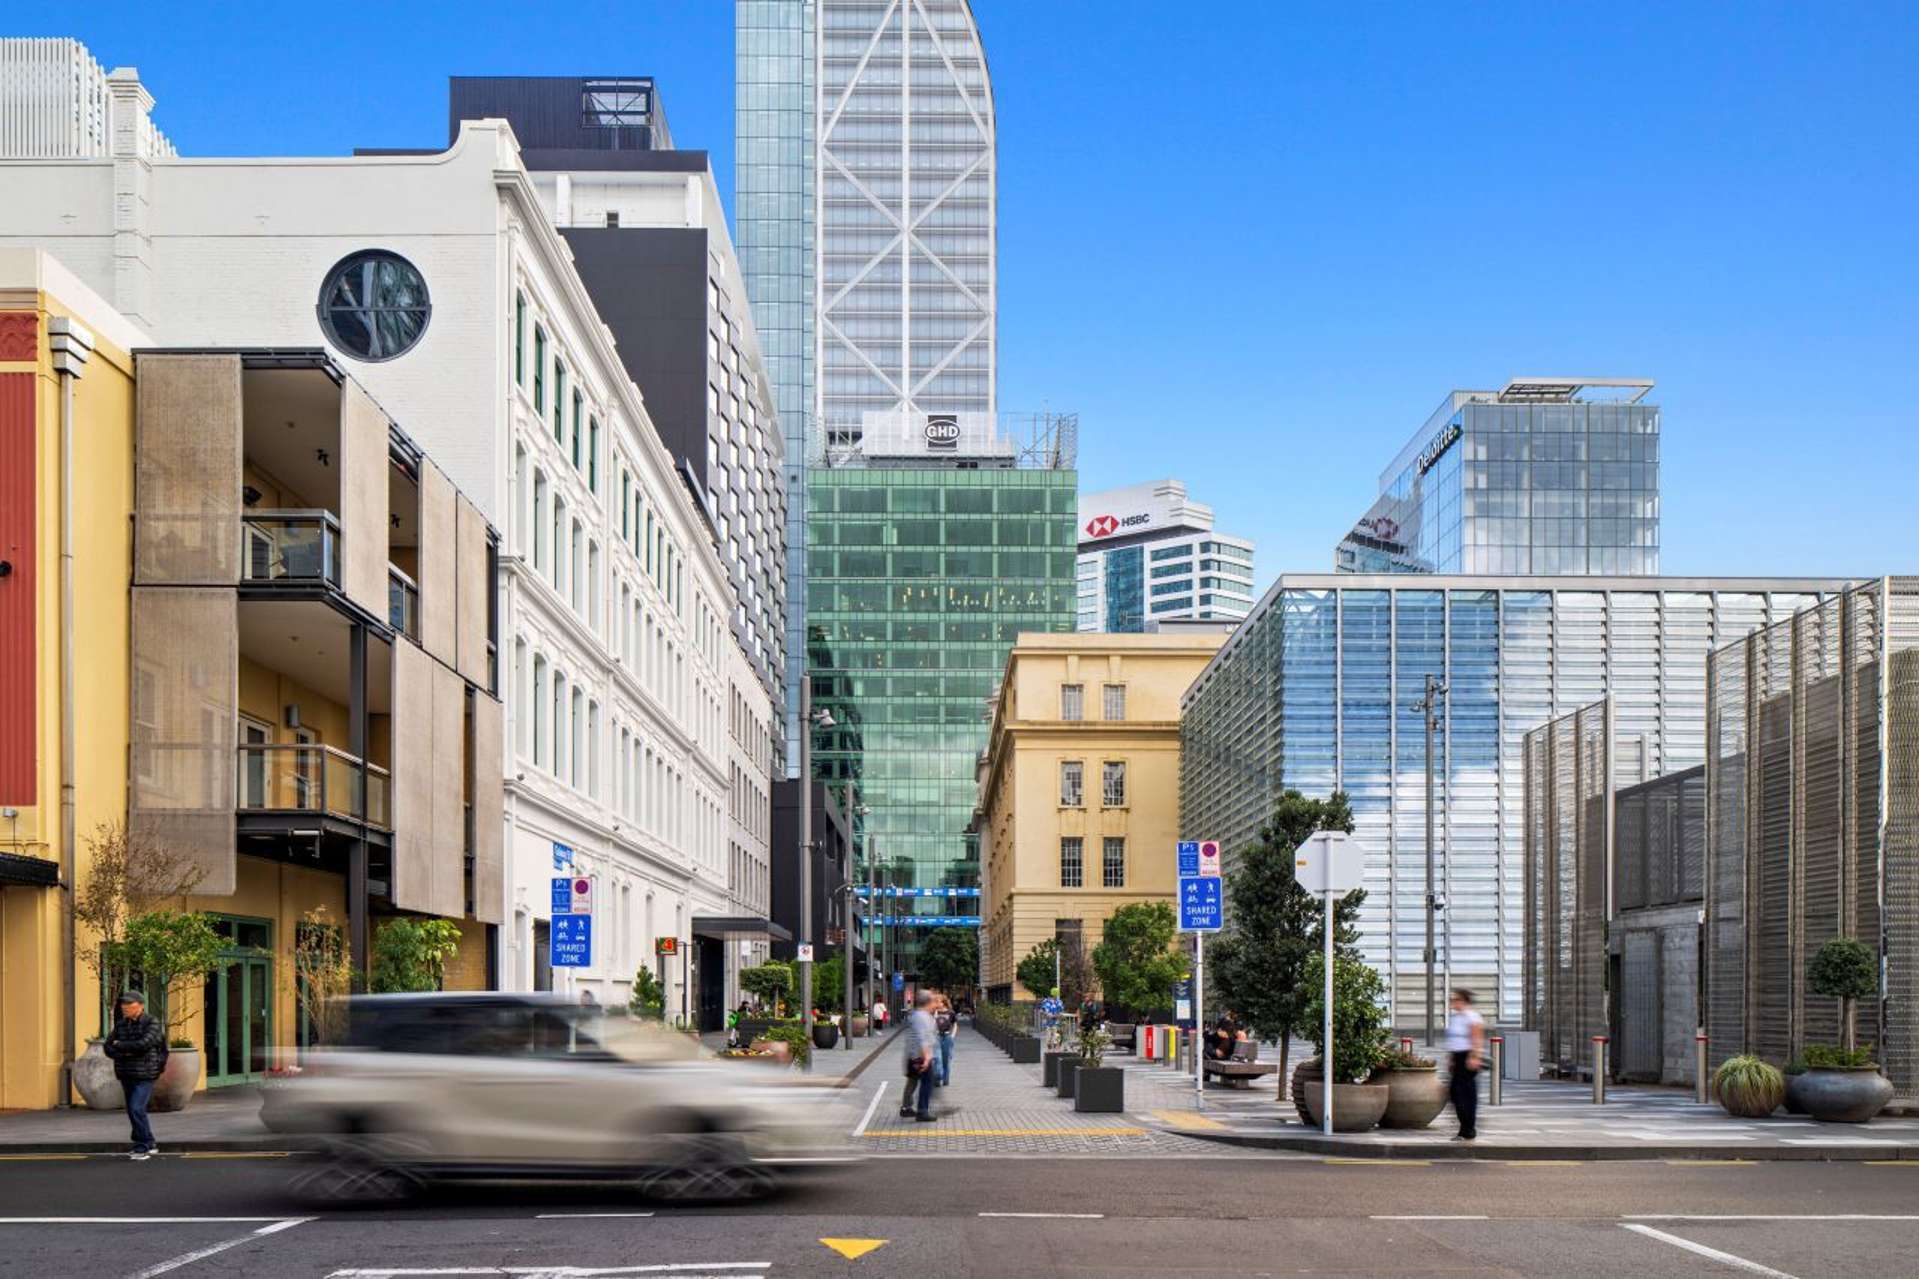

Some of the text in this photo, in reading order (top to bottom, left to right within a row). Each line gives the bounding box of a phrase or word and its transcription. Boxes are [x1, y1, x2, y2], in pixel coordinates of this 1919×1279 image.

[926, 425, 959, 437] GHD
[1121, 513, 1151, 527] HSBC
[1186, 906, 1217, 916] SHARED
[1191, 916, 1211, 926] ZONE
[555, 943, 586, 953] SHARED
[561, 953, 581, 964] ZONE
